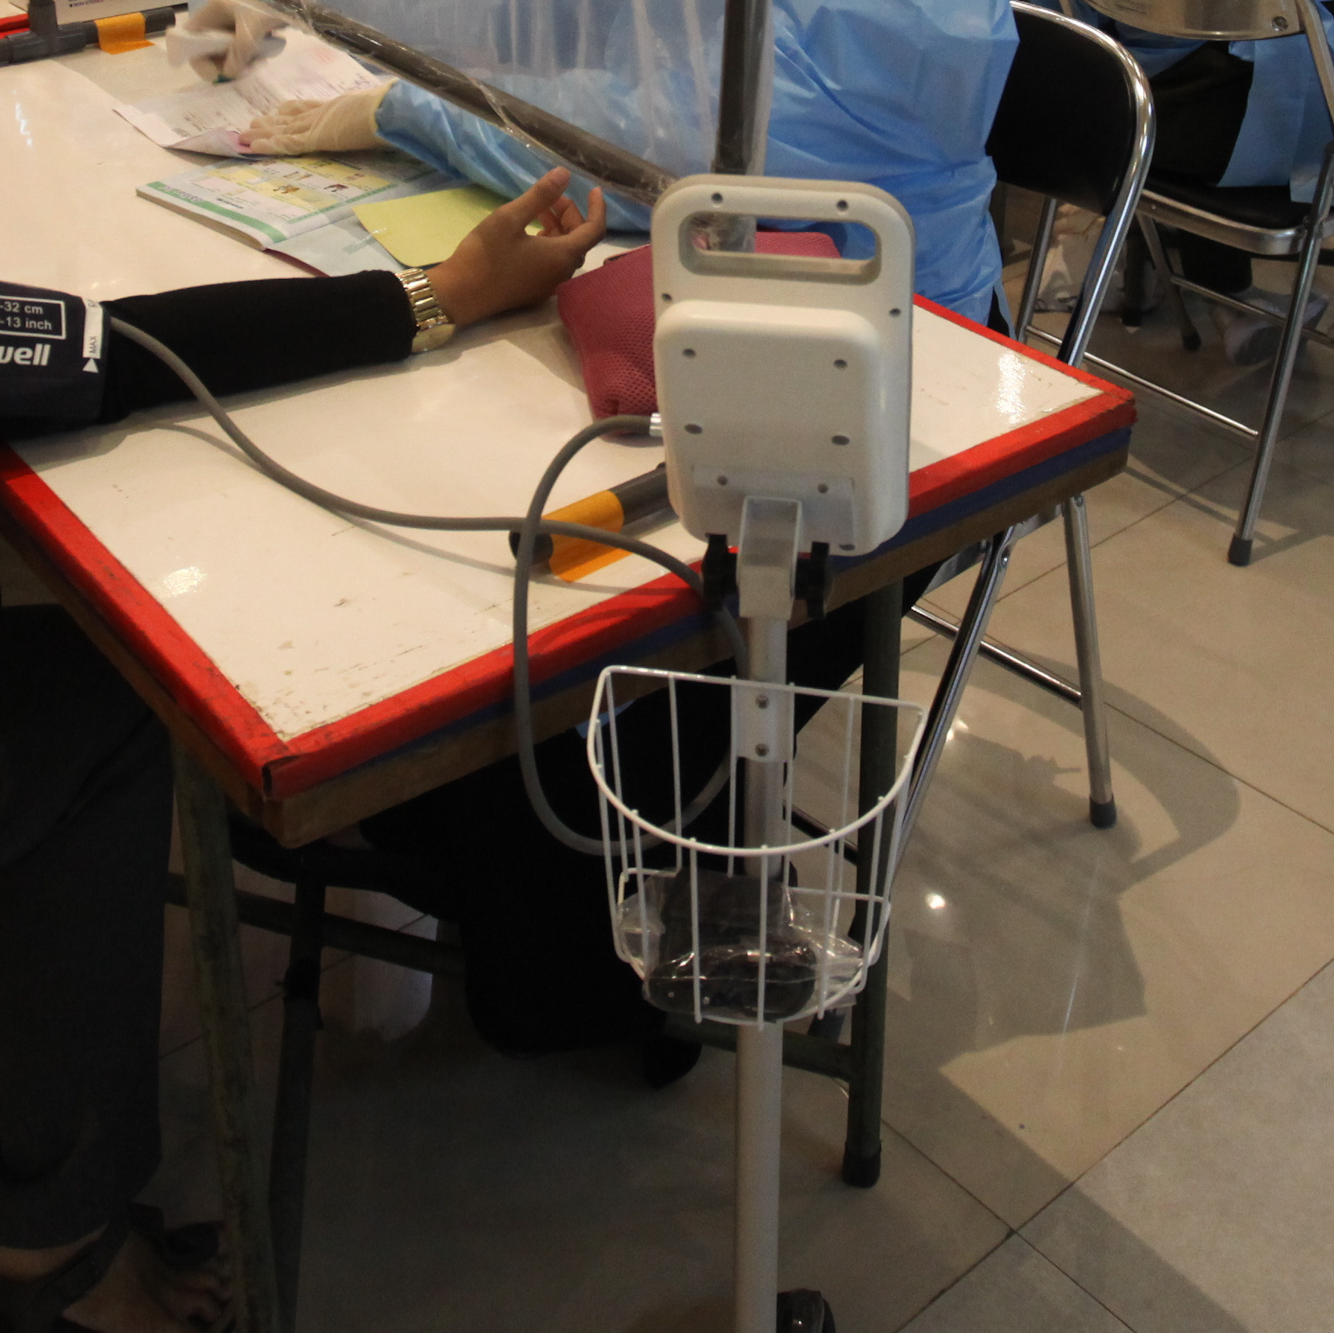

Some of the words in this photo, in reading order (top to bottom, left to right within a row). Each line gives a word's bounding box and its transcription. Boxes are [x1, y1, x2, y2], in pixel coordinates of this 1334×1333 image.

[24, 304, 43, 315] cm
[25, 317, 52, 331] inch
[89, 335, 98, 354] MAX
